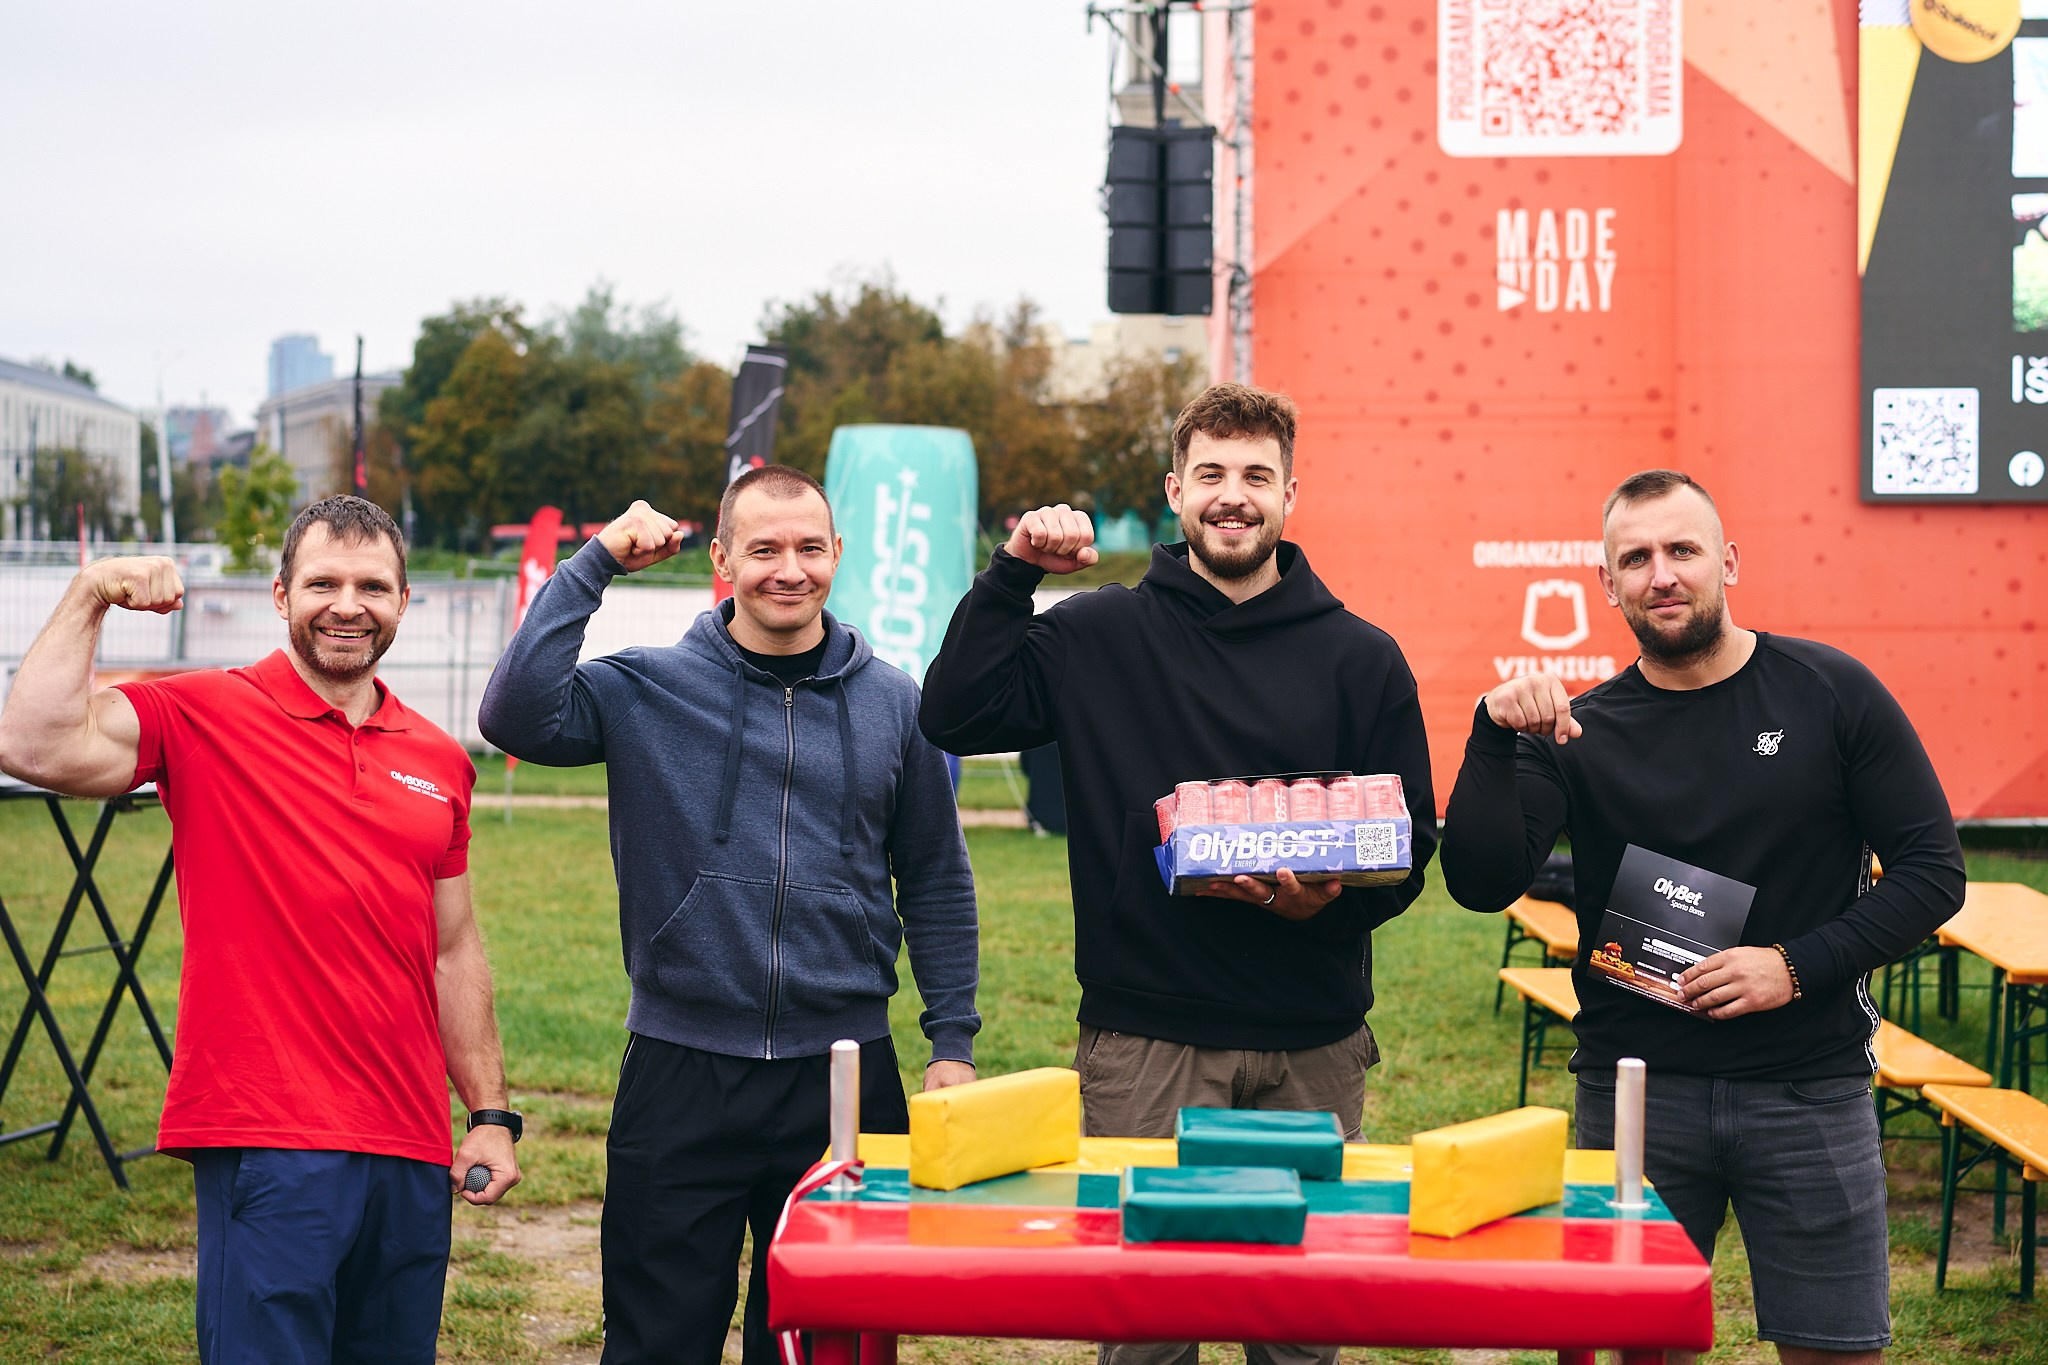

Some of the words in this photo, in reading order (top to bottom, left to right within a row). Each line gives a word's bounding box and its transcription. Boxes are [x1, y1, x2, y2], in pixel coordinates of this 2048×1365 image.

[1496, 208, 1617, 260] MADE
[1535, 260, 1617, 312] DAY
[1493, 655, 1616, 681] VILNIUS
[1188, 829, 1336, 868] OlyBOOST
[1234, 859, 1257, 868] ENERGY
[1653, 877, 1703, 906] OlyBet
